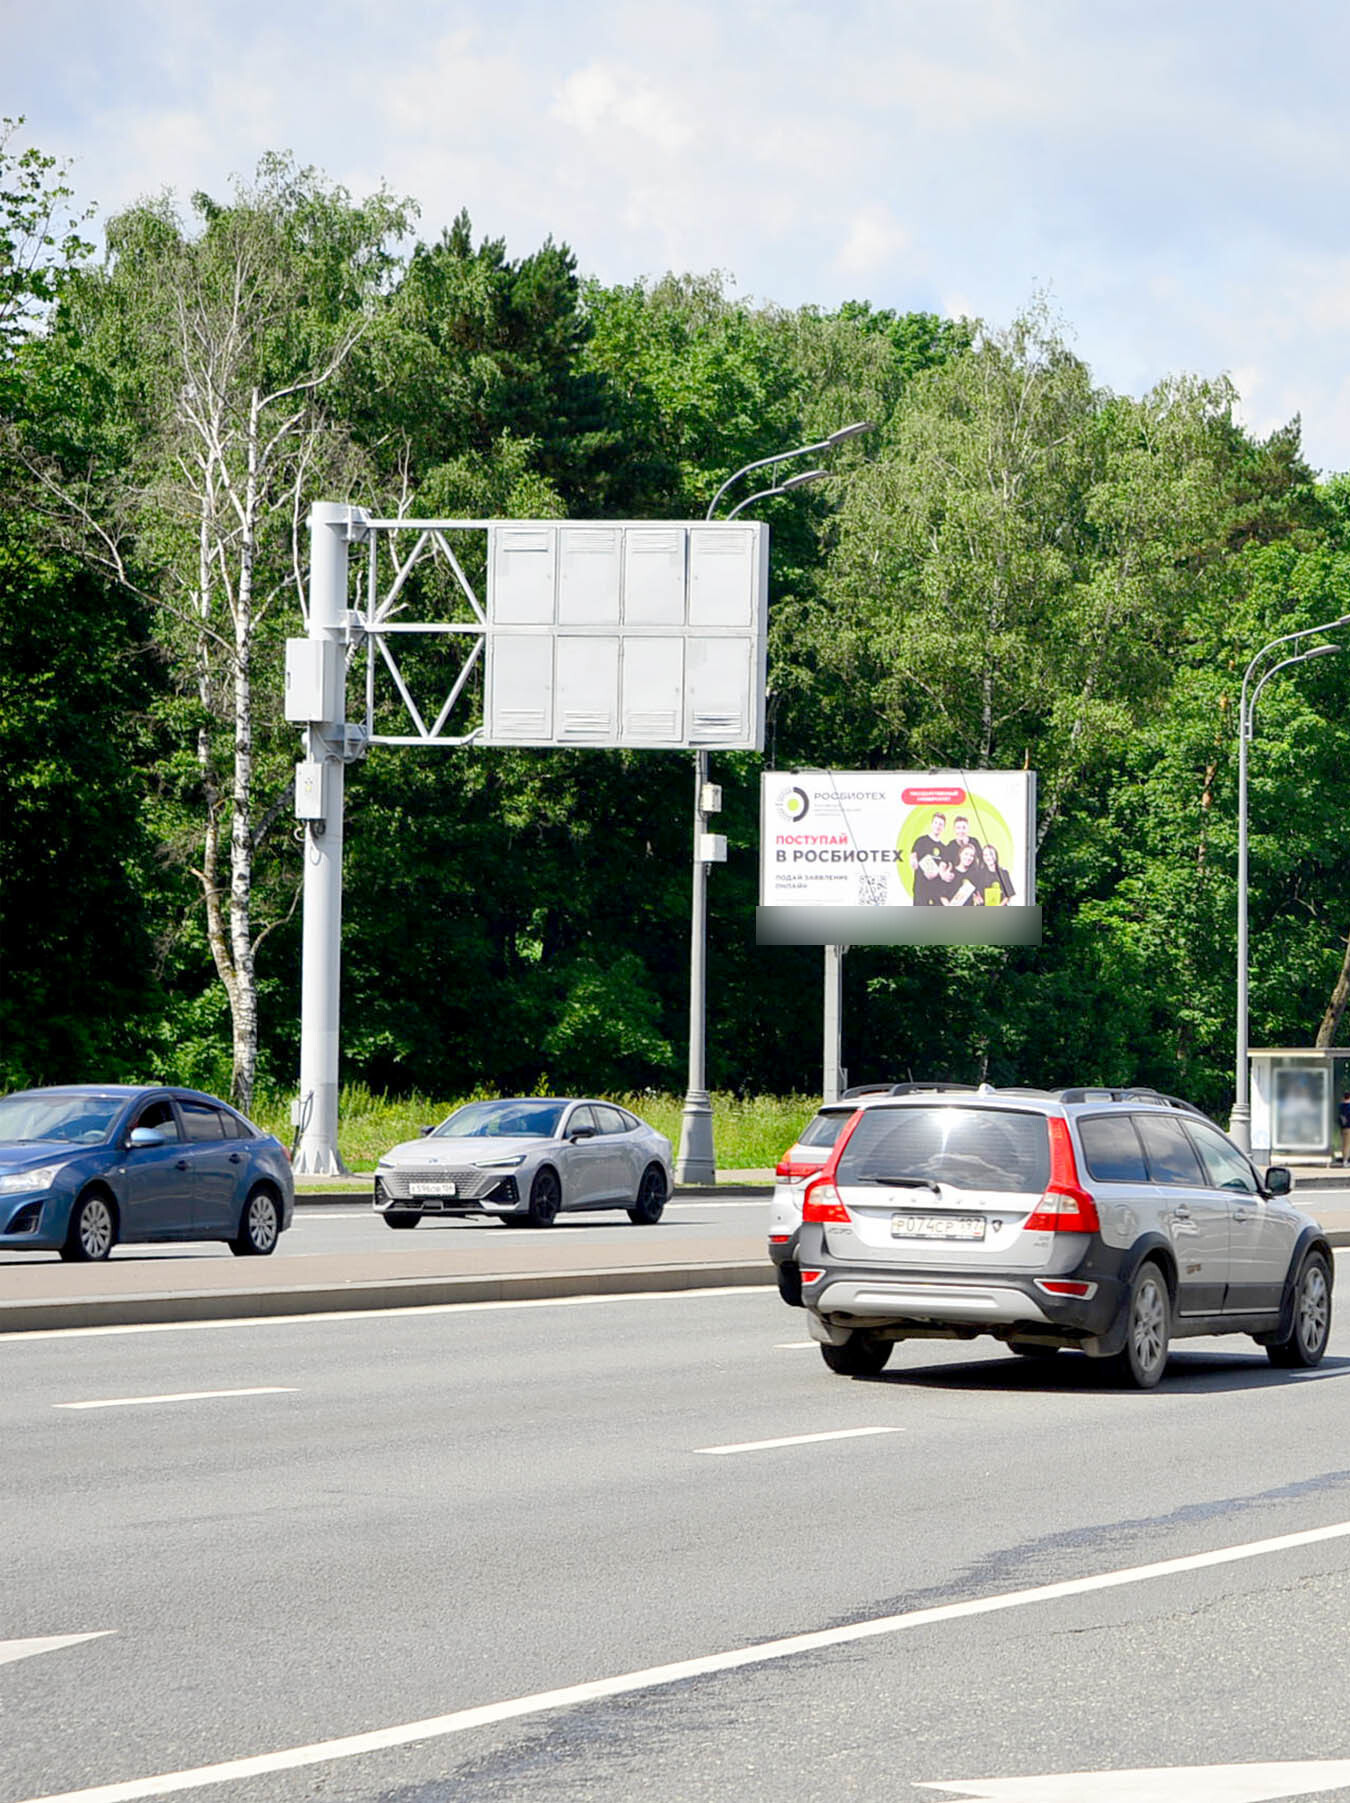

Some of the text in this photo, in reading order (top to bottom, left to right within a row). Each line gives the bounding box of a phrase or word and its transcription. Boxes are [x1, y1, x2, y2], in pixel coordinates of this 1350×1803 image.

[814, 792, 886, 801] РОСБИОТЕХ
[776, 833, 848, 845] ПОСТУПАЙ
[776, 849, 904, 863] В РОСБИОТЕХ
